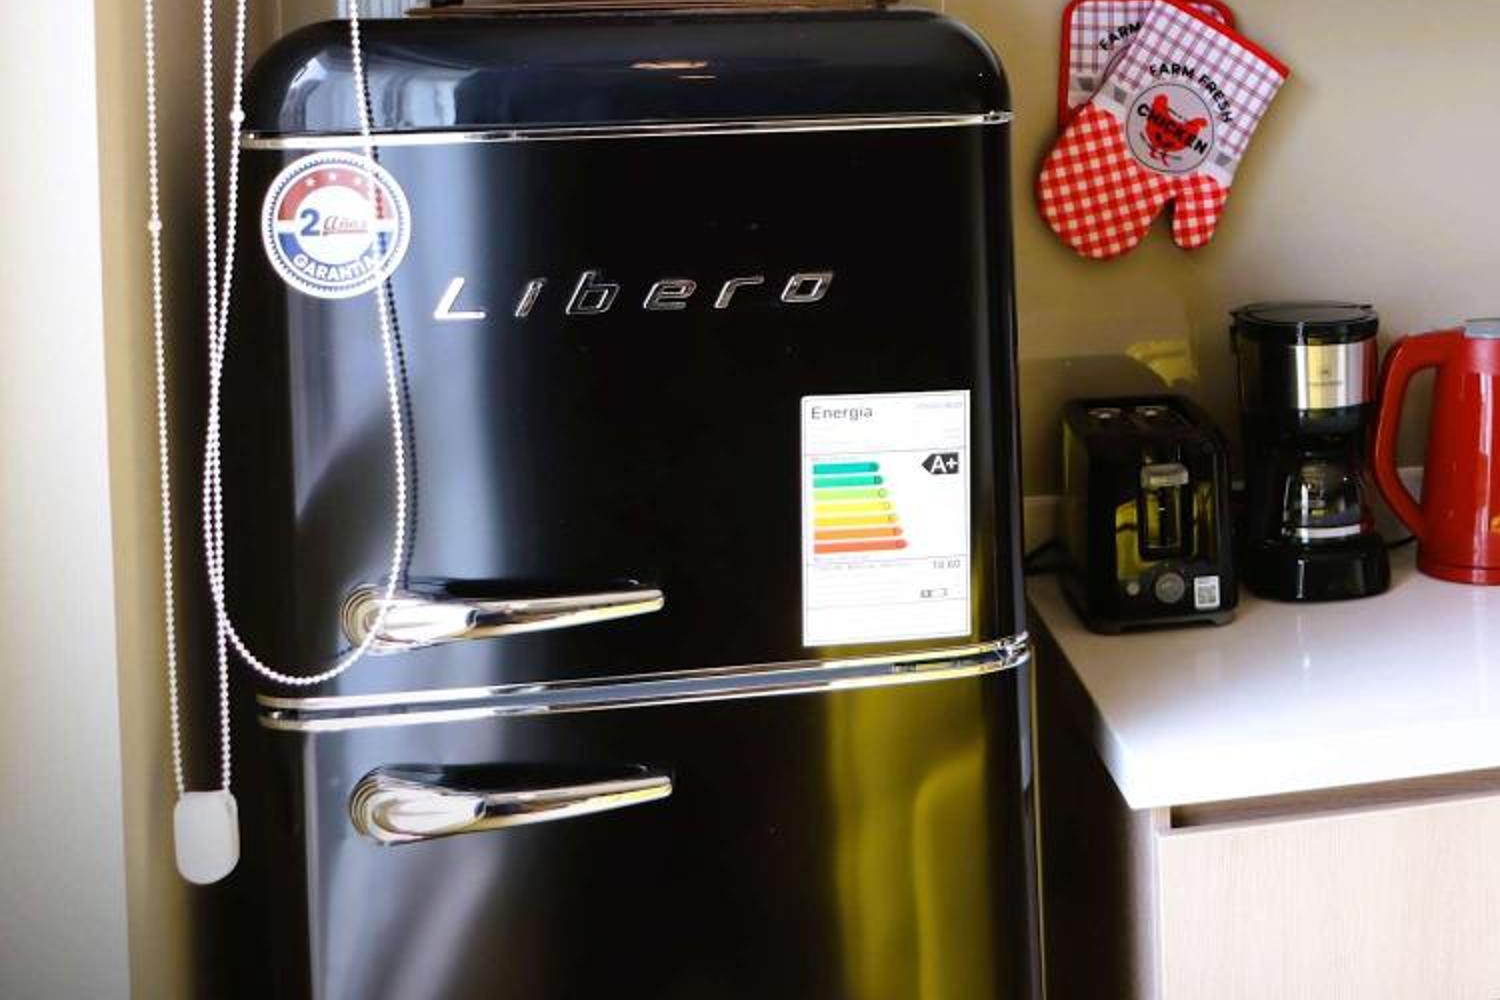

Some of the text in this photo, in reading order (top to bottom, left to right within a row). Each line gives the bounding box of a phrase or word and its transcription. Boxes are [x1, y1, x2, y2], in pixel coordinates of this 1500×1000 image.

[1150, 63, 1233, 124] FARM FRESH
[300, 208, 321, 237] 2
[931, 455, 958, 473] A+
